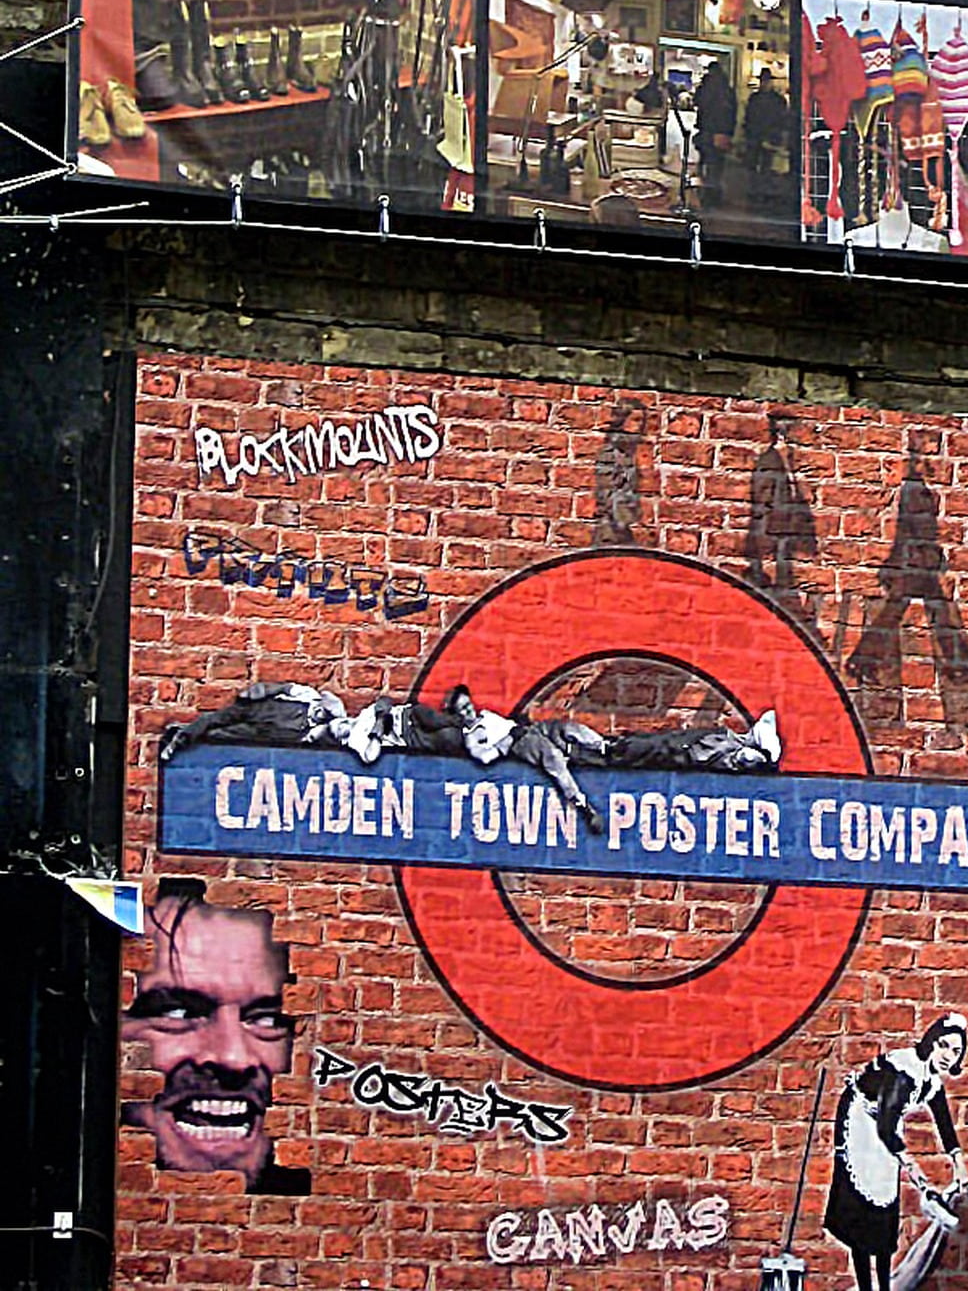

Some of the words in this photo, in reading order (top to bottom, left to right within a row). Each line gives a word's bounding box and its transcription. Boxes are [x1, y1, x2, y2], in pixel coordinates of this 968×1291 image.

[194, 404, 443, 485] BLOCKMOUNTS
[214, 766, 415, 841] CAMDEN
[444, 780, 578, 849] TOWN
[607, 791, 781, 859] POSTER
[313, 1046, 576, 1142] POSTERS
[485, 1193, 731, 1264] CANVAS
